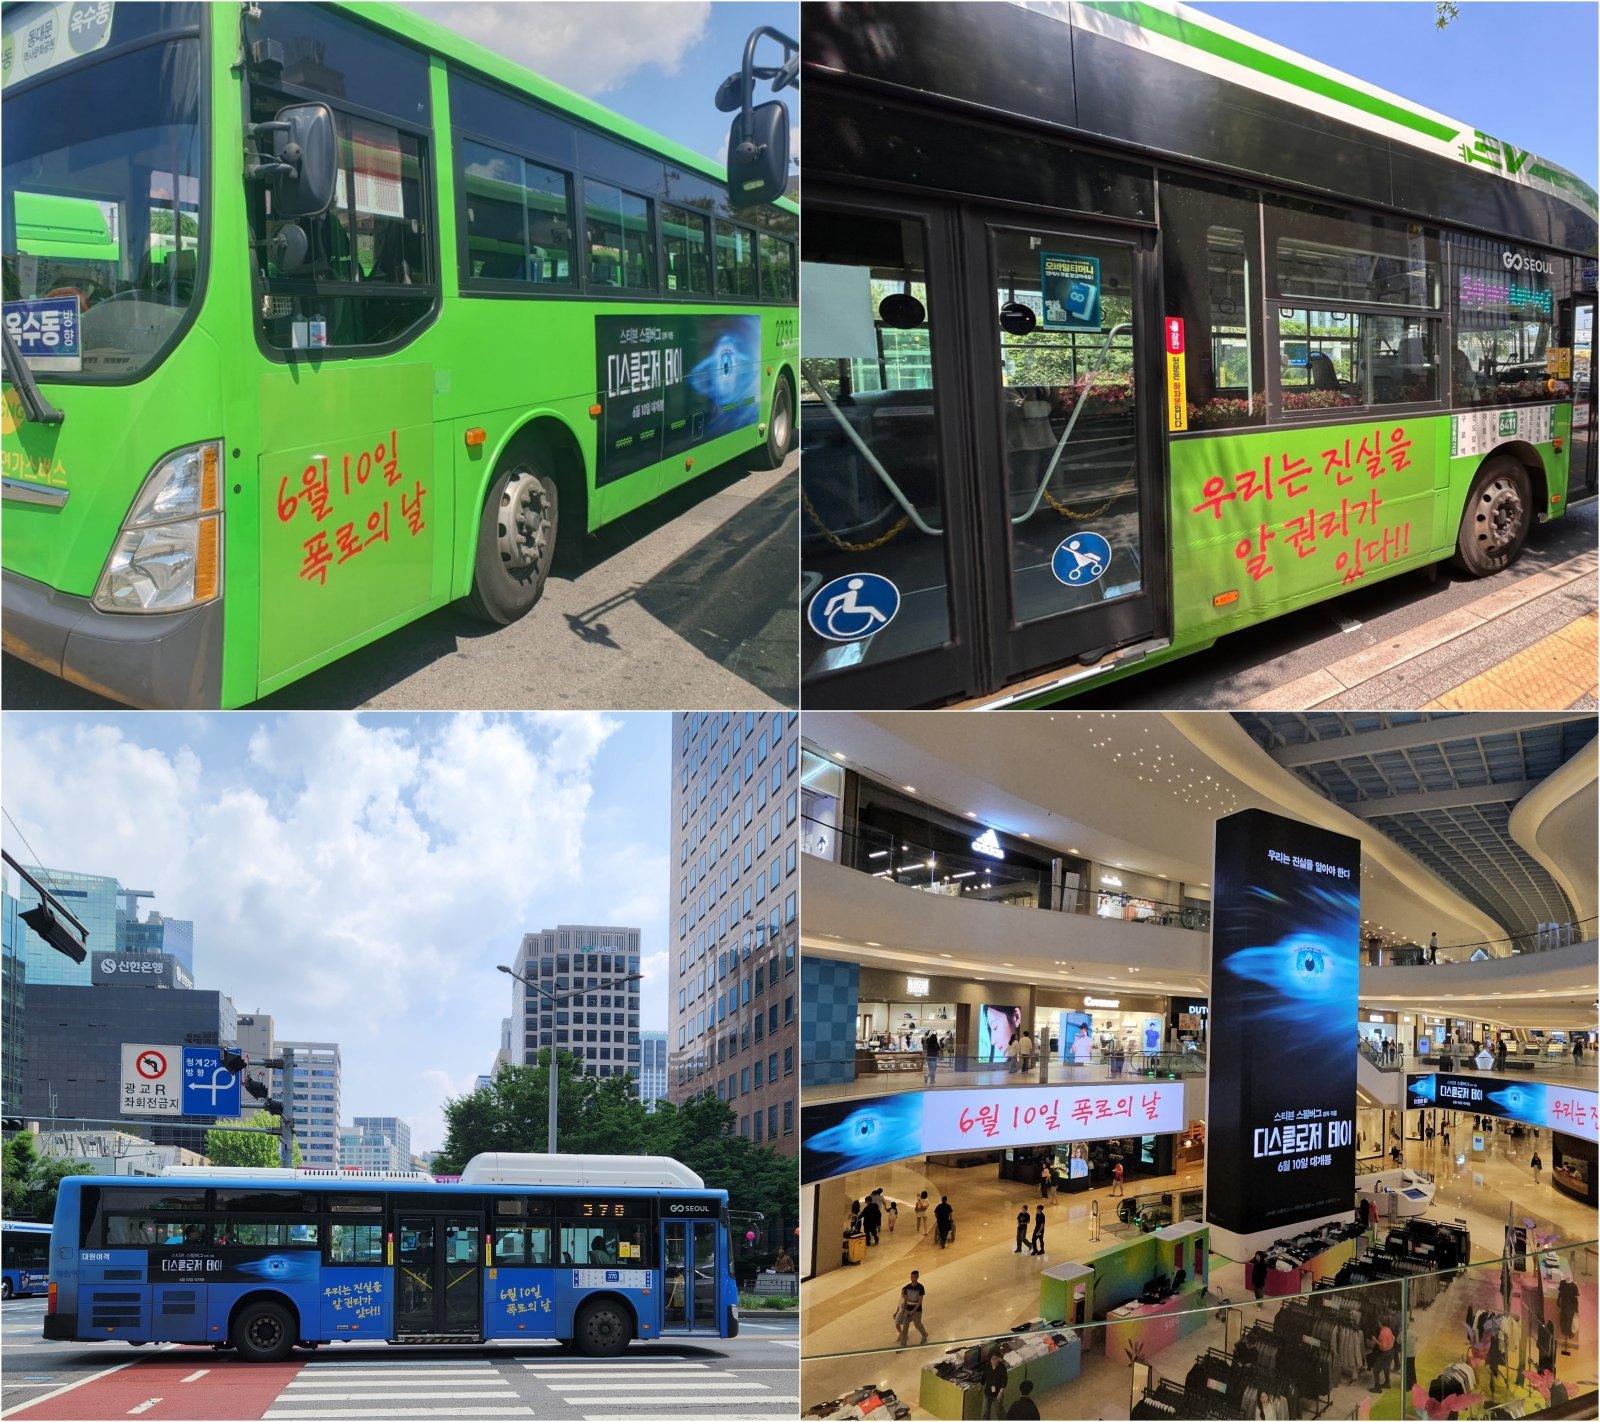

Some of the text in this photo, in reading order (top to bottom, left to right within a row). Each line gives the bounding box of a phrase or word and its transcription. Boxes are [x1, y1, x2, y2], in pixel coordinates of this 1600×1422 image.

[70, 2, 110, 33] 옥수동
[28, 19, 53, 48] 동대문
[1474, 129, 1529, 175] EV
[1503, 252, 1554, 274] GO SEOUL
[5, 309, 74, 347] 옥수동 방향
[775, 320, 793, 347] 2233
[608, 349, 661, 398] 디스클로저
[1500, 417, 1516, 431] 6411
[277, 430, 402, 524] 6월 10일
[1192, 453, 1312, 520] 우리는
[1321, 428, 1412, 486] 진실을
[300, 480, 426, 585] 폭로의 날
[1235, 488, 1383, 582] 알 권리가
[1335, 522, 1410, 586] 있다!!
[1268, 849, 1351, 880] 우리는 진실을 알아야 한다
[118, 961, 164, 974] 신한은행
[186, 1058, 218, 1068] 청계2가
[155, 1084, 166, 1096] R
[124, 1097, 179, 1110] 좌회전금지
[1552, 1099, 1586, 1126] 우리는
[959, 1091, 1162, 1138] 6월 10일 폭로의 날
[1274, 1111, 1295, 1121] 스티븐
[1296, 1109, 1322, 1120] 스필버그
[1253, 1122, 1322, 1158] 디스클로저
[1277, 1154, 1332, 1172] 6월 10일 대개봉
[583, 1204, 624, 1216] 370
[670, 1204, 684, 1213] GO
[82, 1252, 110, 1261] 대원여객
[162, 1259, 202, 1272] 디스클로저
[324, 1281, 382, 1297] 우리는 진실을
[500, 1284, 542, 1302] 6월 10일
[332, 1295, 372, 1311] 알 권리가
[355, 1306, 381, 1319] 있다!!
[506, 1298, 551, 1316] 폭로의 날
